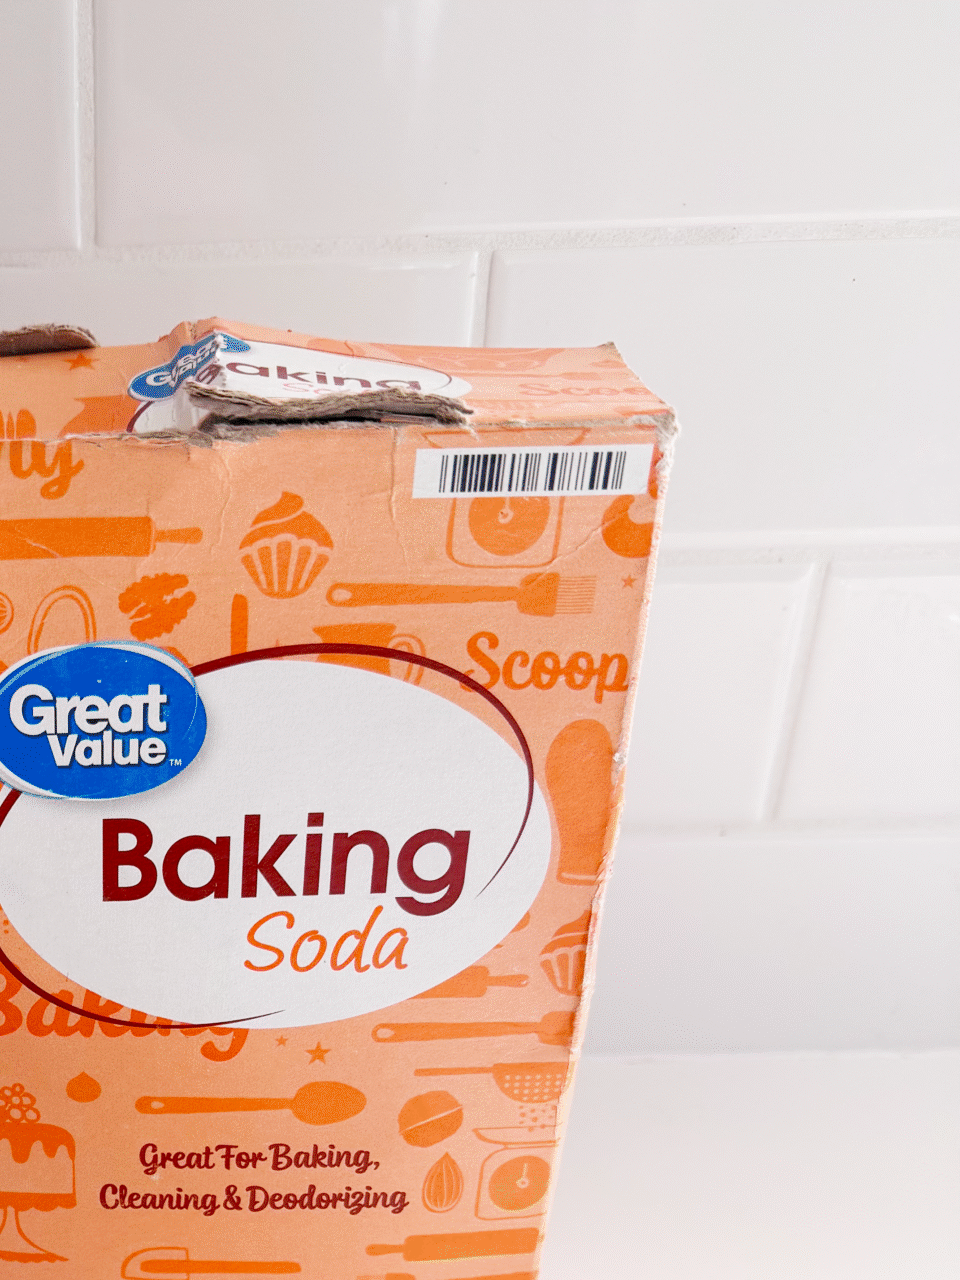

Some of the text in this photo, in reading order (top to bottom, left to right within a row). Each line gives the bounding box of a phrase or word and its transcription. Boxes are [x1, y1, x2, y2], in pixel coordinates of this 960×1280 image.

[460, 631, 629, 704] Scoop
[9, 684, 168, 736] Great
[47, 730, 168, 767] Value
[101, 812, 471, 916] Baking
[244, 906, 409, 973] Soda
[139, 1143, 380, 1175] Great For Baking,
[99, 1184, 409, 1216] Cleaning & Deodorizing
